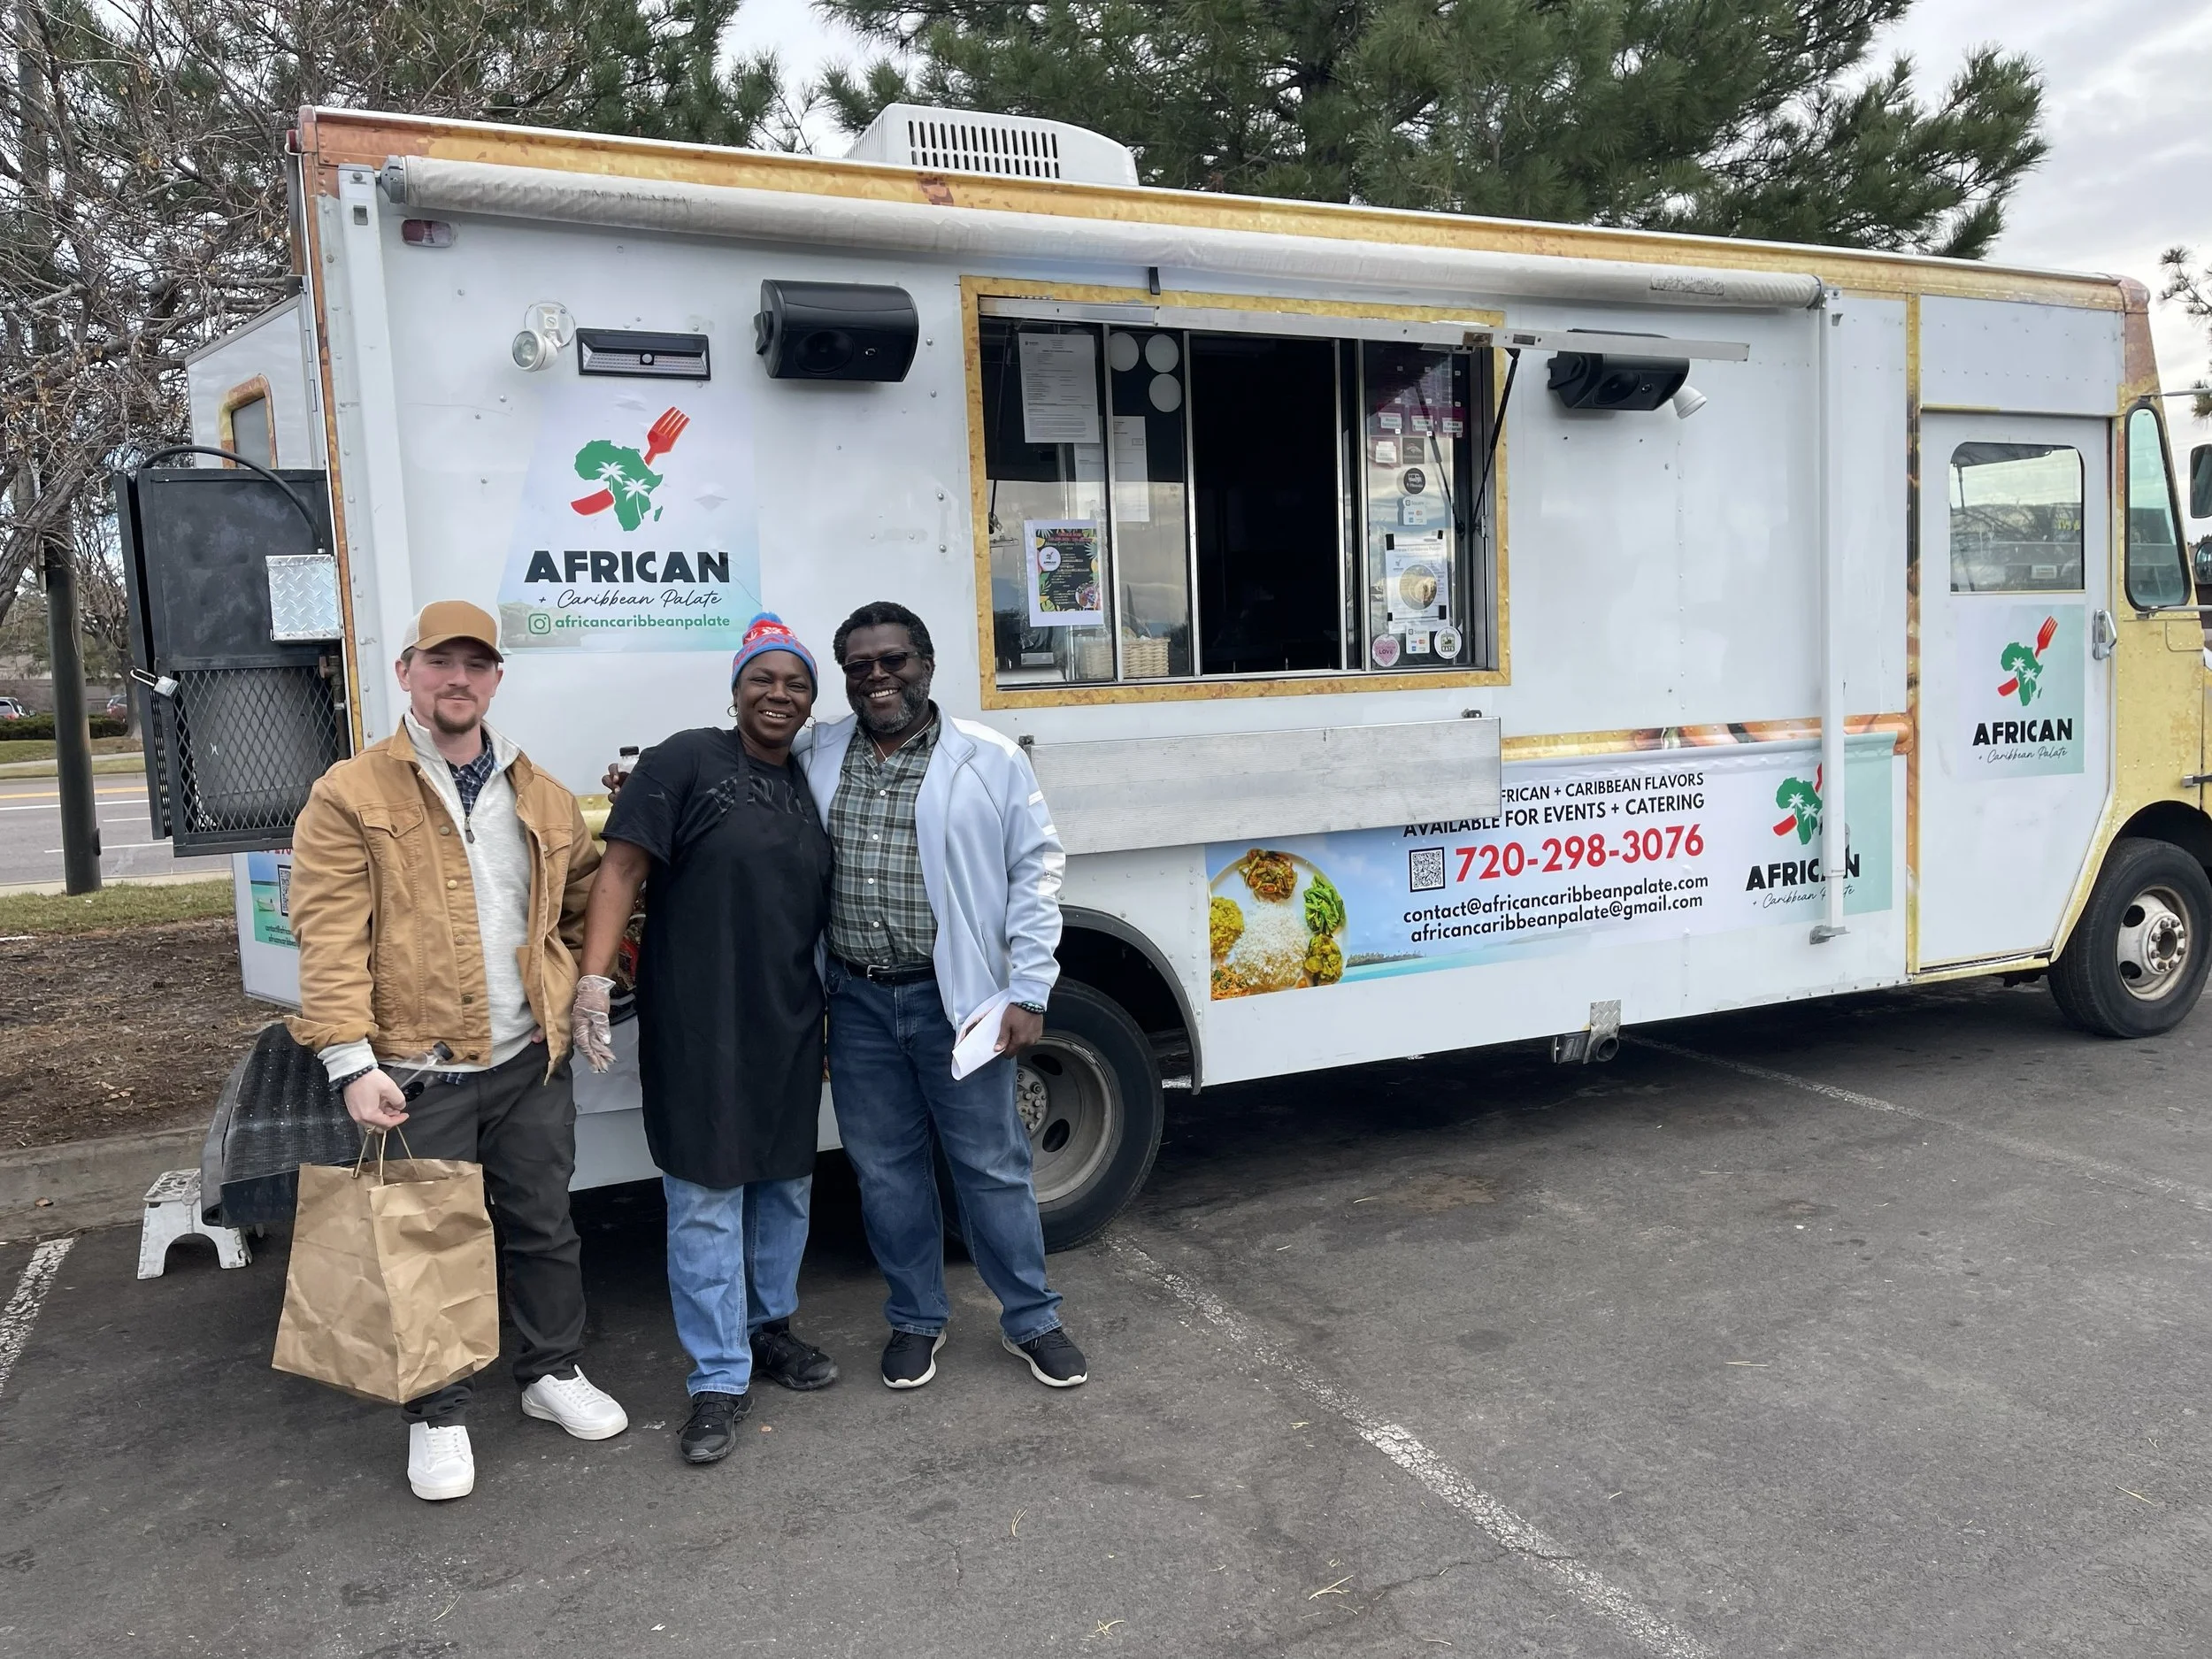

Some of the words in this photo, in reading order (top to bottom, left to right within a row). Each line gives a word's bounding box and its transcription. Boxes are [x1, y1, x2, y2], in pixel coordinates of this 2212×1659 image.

[524, 550, 730, 583] AFRICAN
[557, 588, 655, 609] Caribbean
[656, 588, 722, 609] Palate
[555, 614, 730, 630] africancaribbeanpalate
[1972, 718, 2073, 746] AFRICAN
[1986, 748, 2035, 764] Caribbean
[2036, 746, 2068, 760] Palate
[1502, 785, 1550, 803] FRICAN
[1554, 787, 1562, 796] +
[1565, 777, 1641, 797] CARIBBEAN
[1645, 772, 1704, 791] FLAVORS
[1402, 817, 1501, 838] AVAILABLE
[1505, 809, 1540, 827] FOR
[1544, 801, 1606, 824] EVENTS
[1611, 803, 1620, 813] +
[1625, 793, 1705, 815] CATERING
[1455, 823, 1704, 882] 720-298-3076
[1746, 854, 1860, 891] AFRICN
[1403, 876, 1709, 924] contact@africancaribbeanpalate.com
[1763, 890, 1817, 908] Caribbean
[1410, 895, 1703, 943] africancaribbeanpalate@gmail.com
